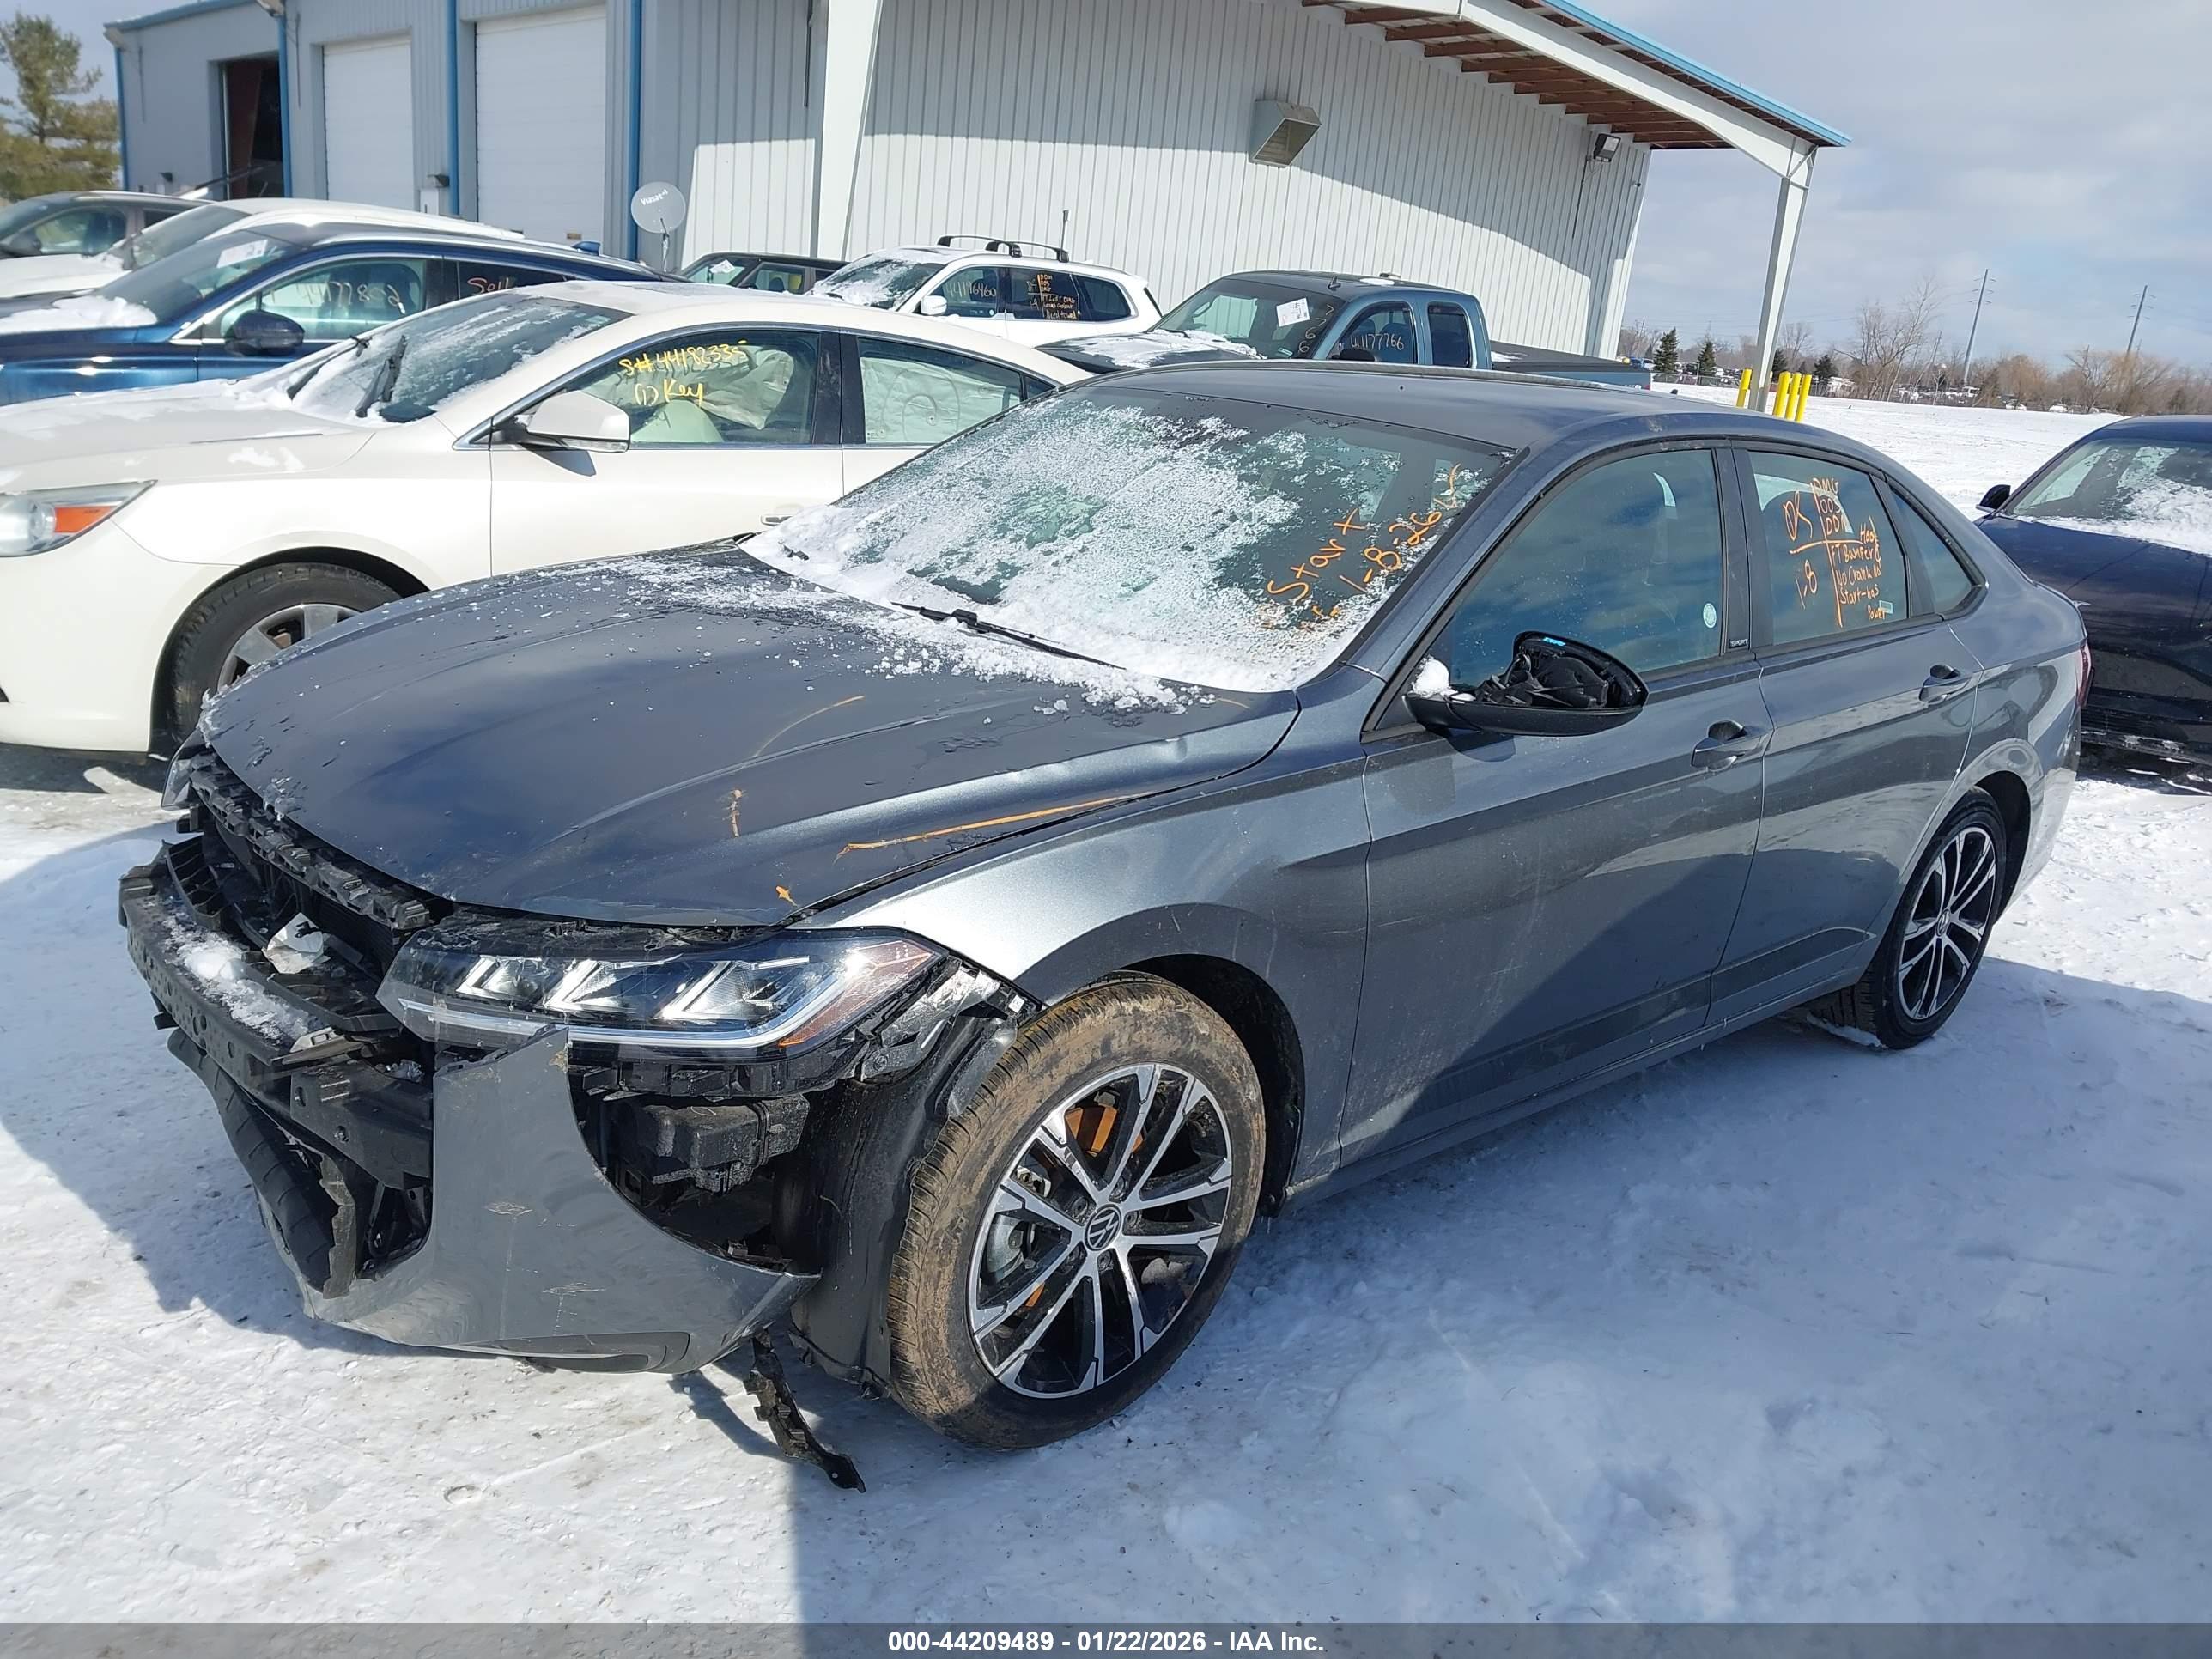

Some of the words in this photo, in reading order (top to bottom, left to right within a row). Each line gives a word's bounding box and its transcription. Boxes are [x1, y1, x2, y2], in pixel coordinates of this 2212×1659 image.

[664, 378, 704, 408] Key
[1267, 507, 1367, 603] Start
[1729, 638, 1749, 647] SPORT
